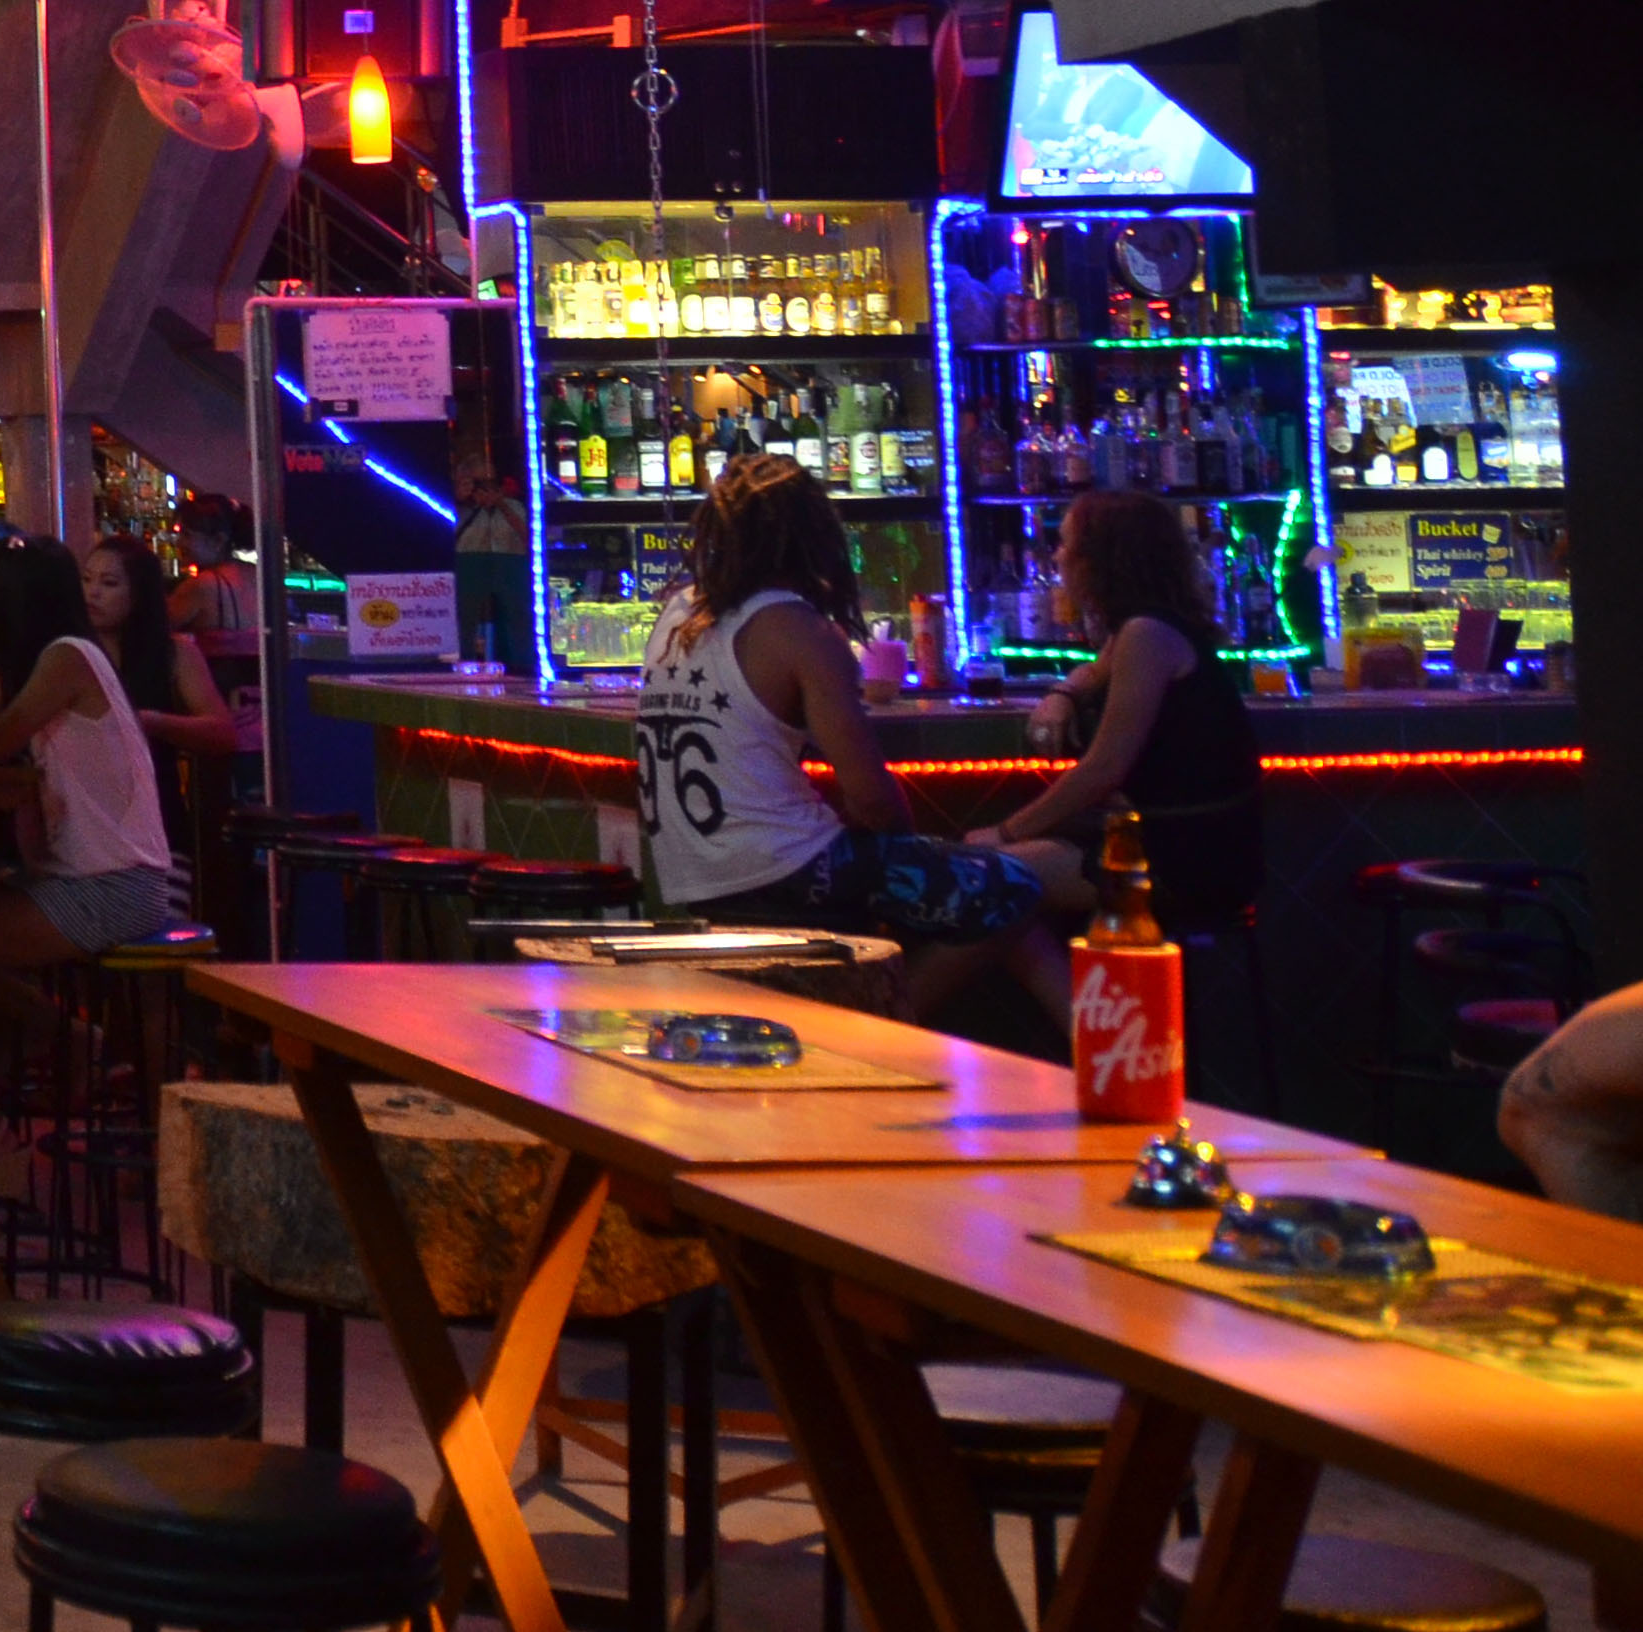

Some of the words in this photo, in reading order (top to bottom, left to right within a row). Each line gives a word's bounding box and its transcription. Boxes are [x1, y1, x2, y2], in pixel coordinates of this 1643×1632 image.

[1417, 519, 1479, 537] Bucket
[1416, 548, 1441, 561] Thai
[1443, 547, 1484, 562] whiskey
[1415, 564, 1452, 581] Spirit
[1072, 963, 1142, 1031] Air
